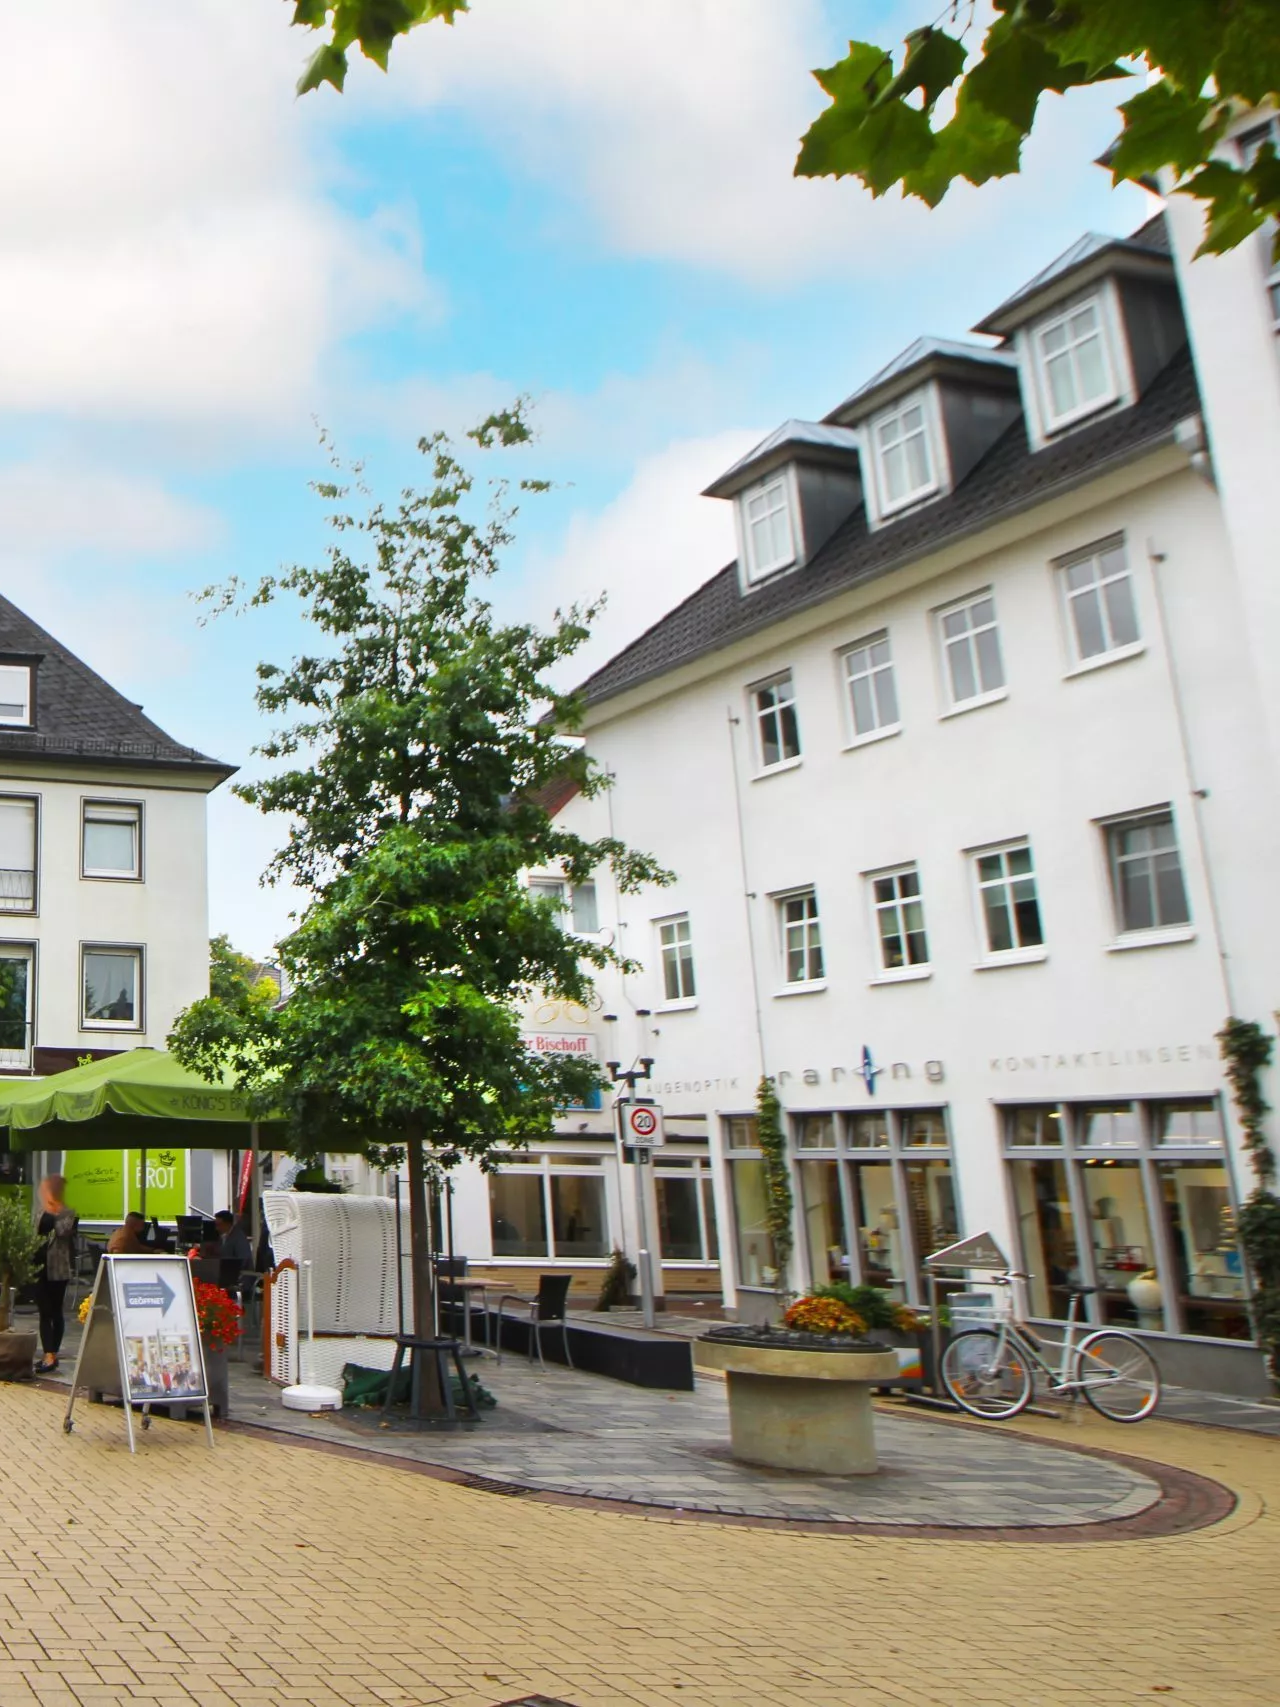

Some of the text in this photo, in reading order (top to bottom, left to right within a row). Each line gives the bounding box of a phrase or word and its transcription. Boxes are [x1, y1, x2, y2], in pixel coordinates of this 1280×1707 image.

[536, 1036, 587, 1051] Bischoff
[989, 1046, 1213, 1072] KONTAKTLINSEN
[646, 1078, 738, 1094] AUGENOPTIK
[636, 1115, 651, 1128] 20
[635, 1136, 655, 1144] ZONE
[129, 1297, 164, 1305] GEÖFFNET
